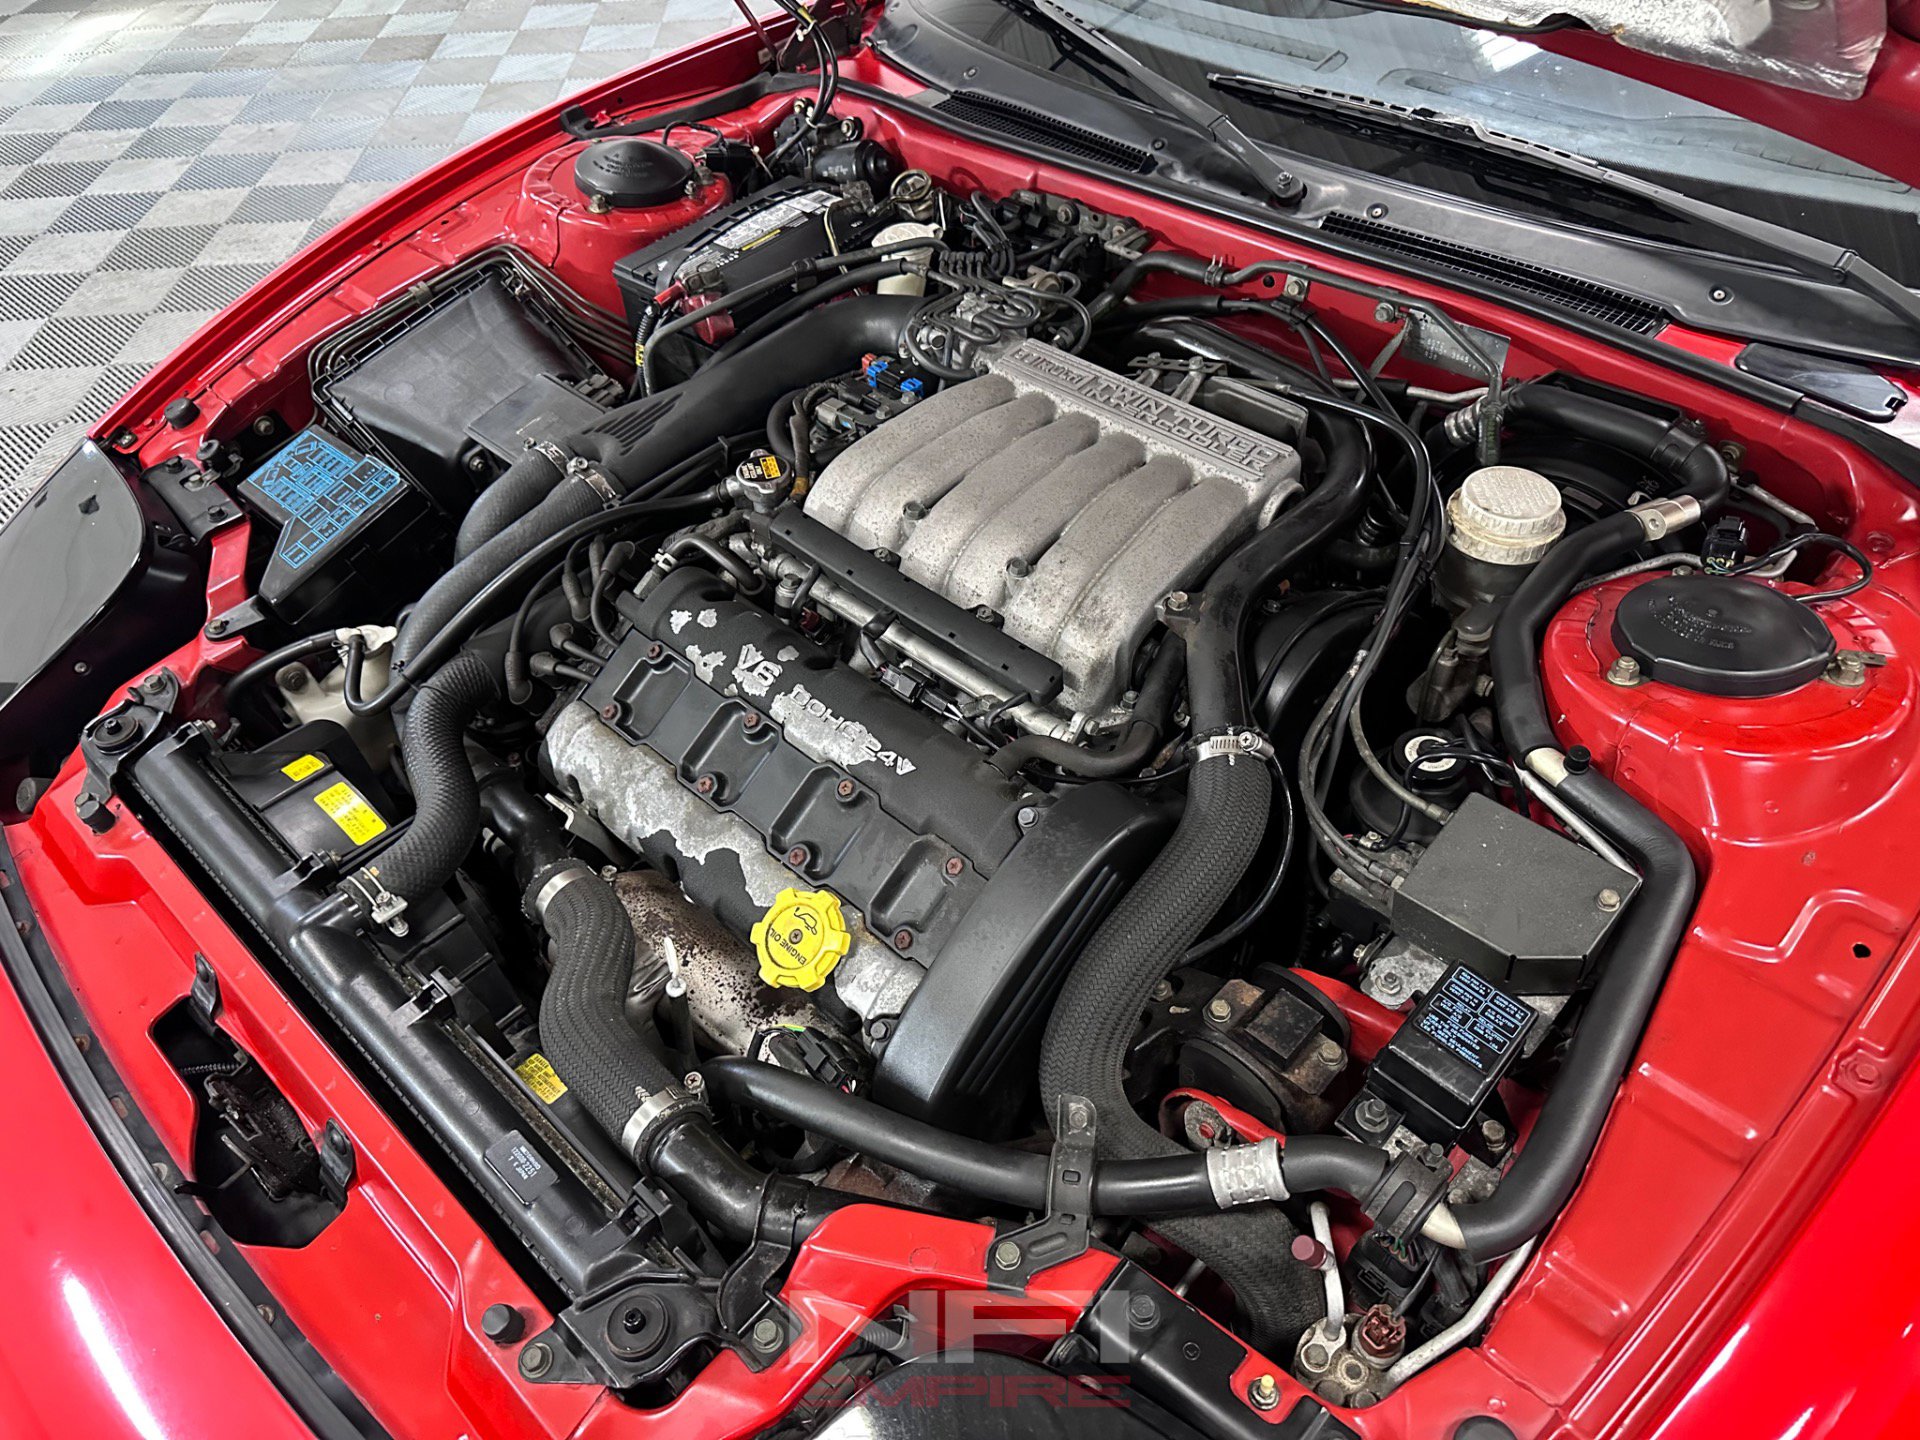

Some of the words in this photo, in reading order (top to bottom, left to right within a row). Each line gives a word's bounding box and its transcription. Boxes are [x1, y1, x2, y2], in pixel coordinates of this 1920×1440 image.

[1078, 385, 1270, 472] INTERCOOLER
[1087, 376, 1170, 416] TWIN
[1164, 409, 1282, 465] TURBO
[734, 643, 783, 689] V6
[769, 927, 782, 942] OIL
[779, 938, 808, 966] ENGINE
